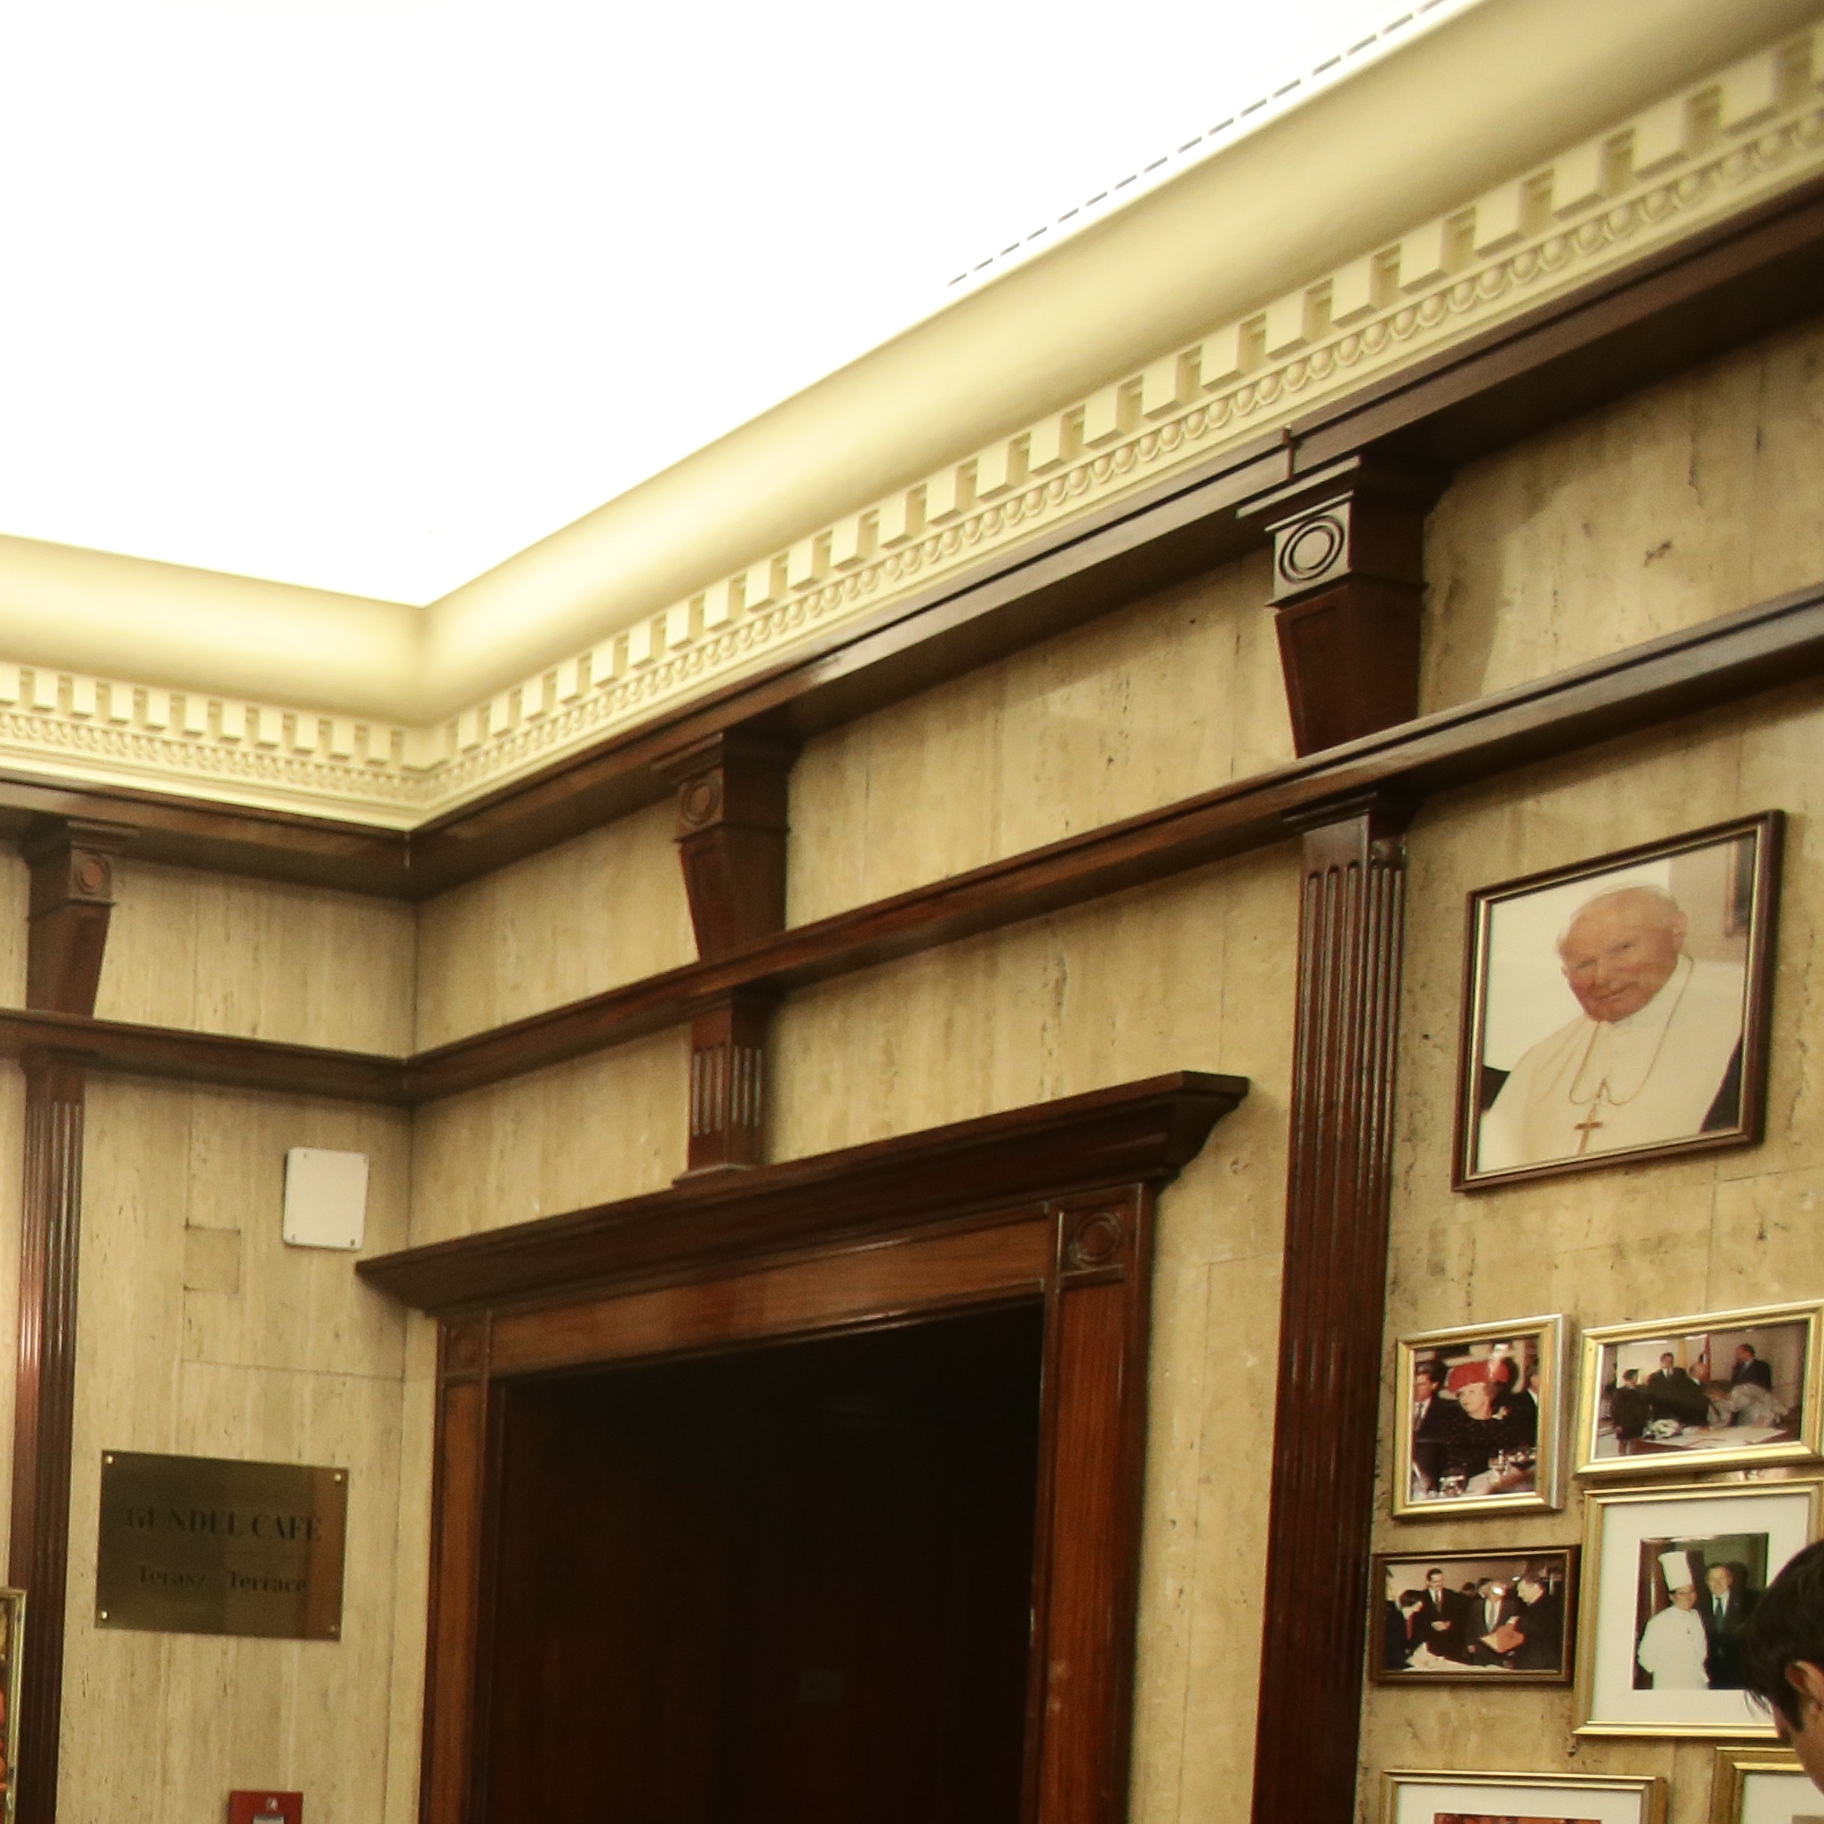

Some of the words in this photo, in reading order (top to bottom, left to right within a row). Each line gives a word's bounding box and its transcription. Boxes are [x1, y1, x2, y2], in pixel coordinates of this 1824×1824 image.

[126, 1505, 238, 1537] GUNDEL
[139, 1565, 207, 1588] Terasz
[229, 1571, 309, 1594] Terrace
